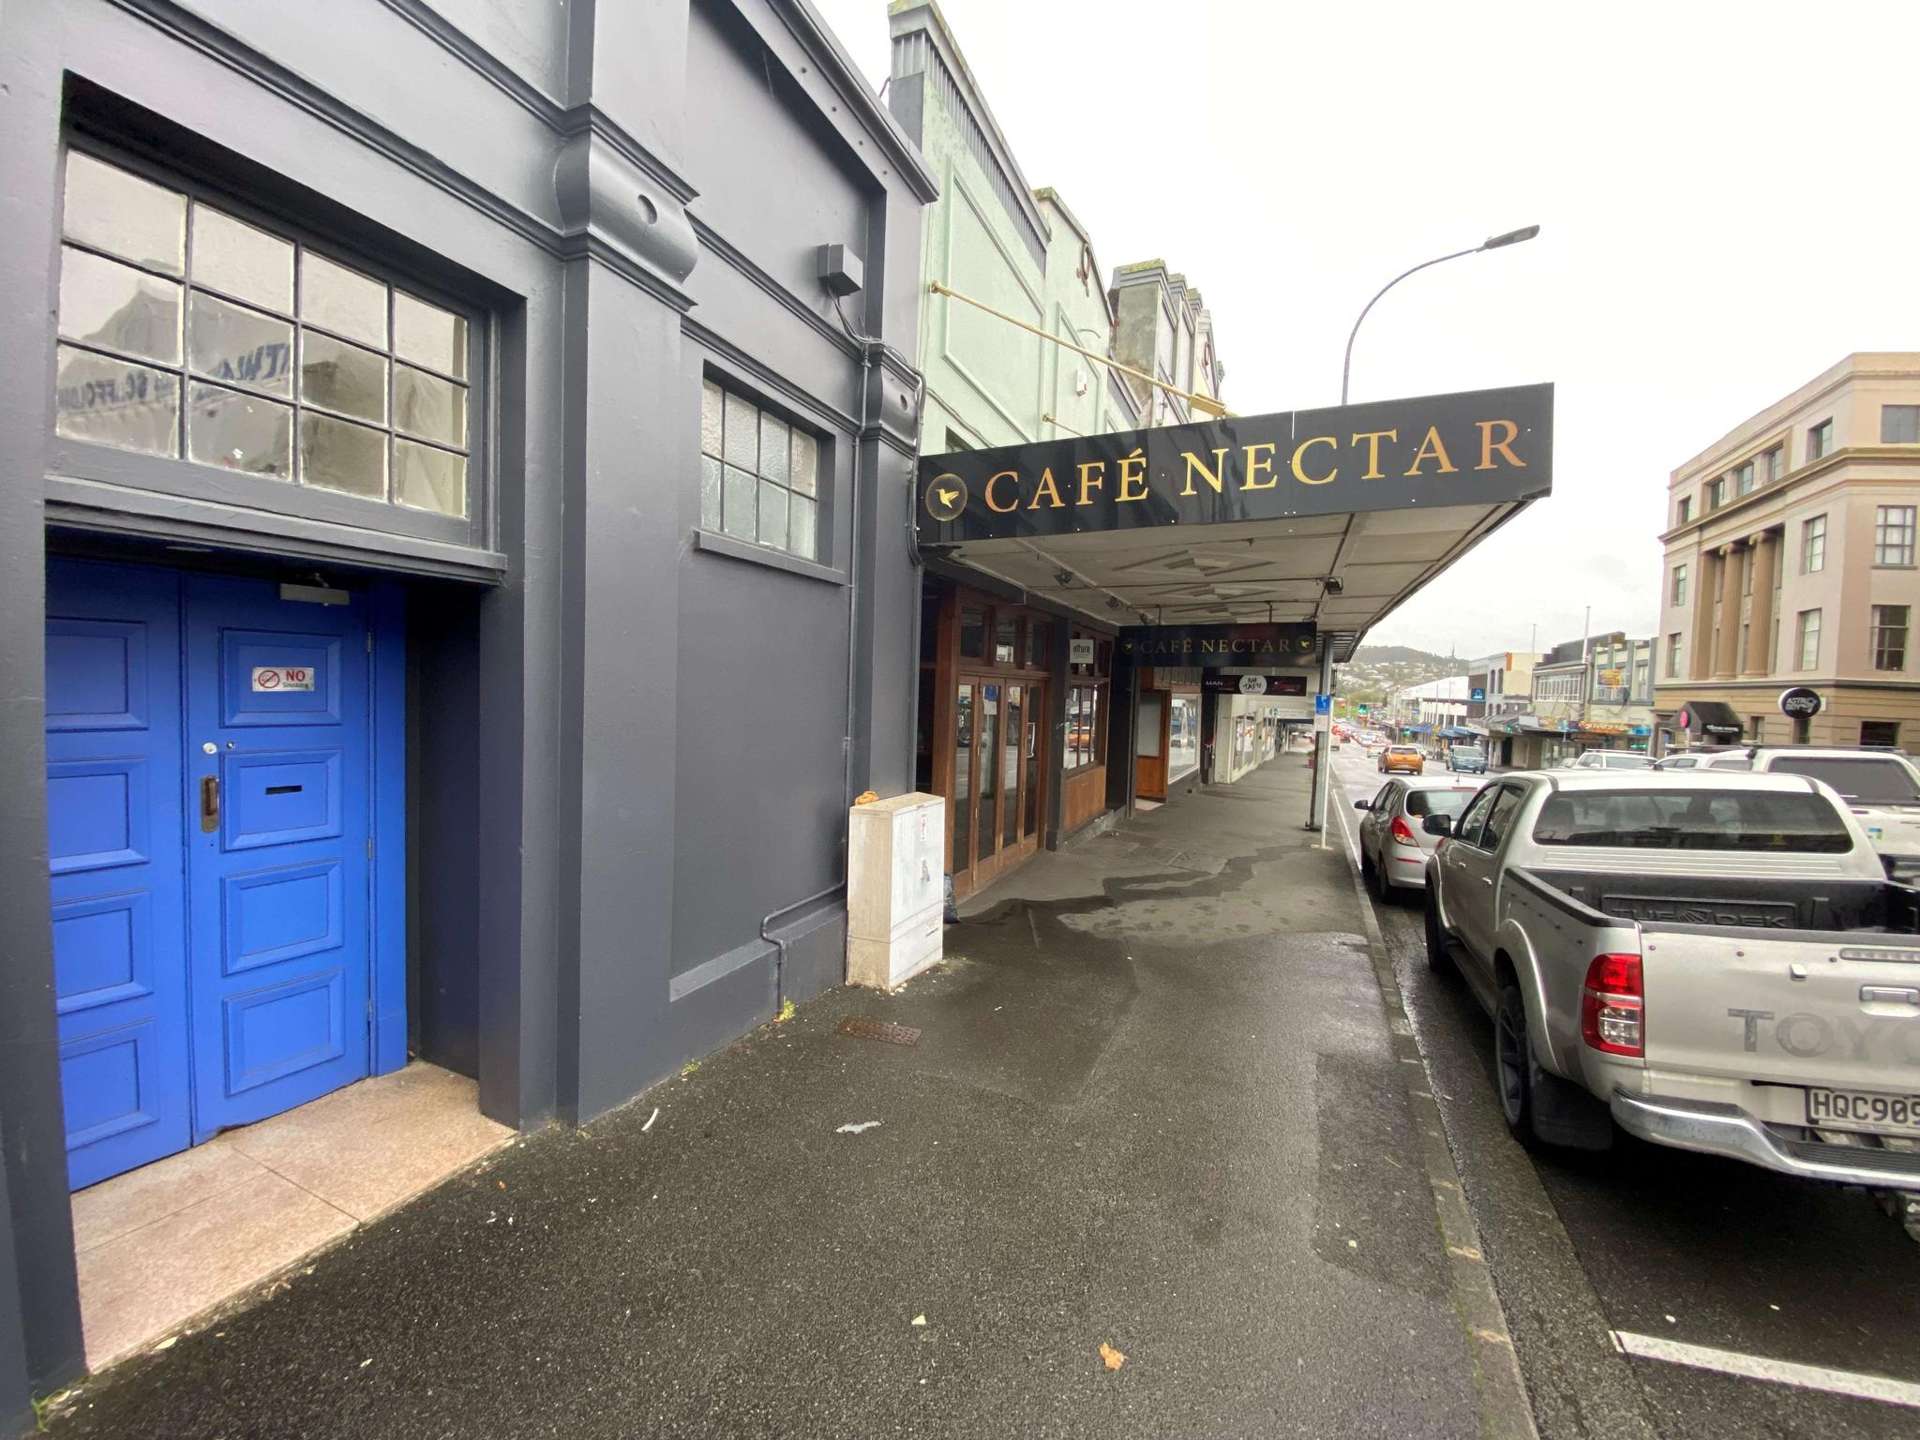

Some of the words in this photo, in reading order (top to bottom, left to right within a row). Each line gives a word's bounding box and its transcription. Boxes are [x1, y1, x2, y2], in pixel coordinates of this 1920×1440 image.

[984, 449, 1149, 513] CAFÉ
[1180, 419, 1528, 496] NECTAR
[1140, 637, 1193, 654] CAFÉ
[1201, 638, 1290, 653] NECTAR
[286, 670, 306, 682] NO
